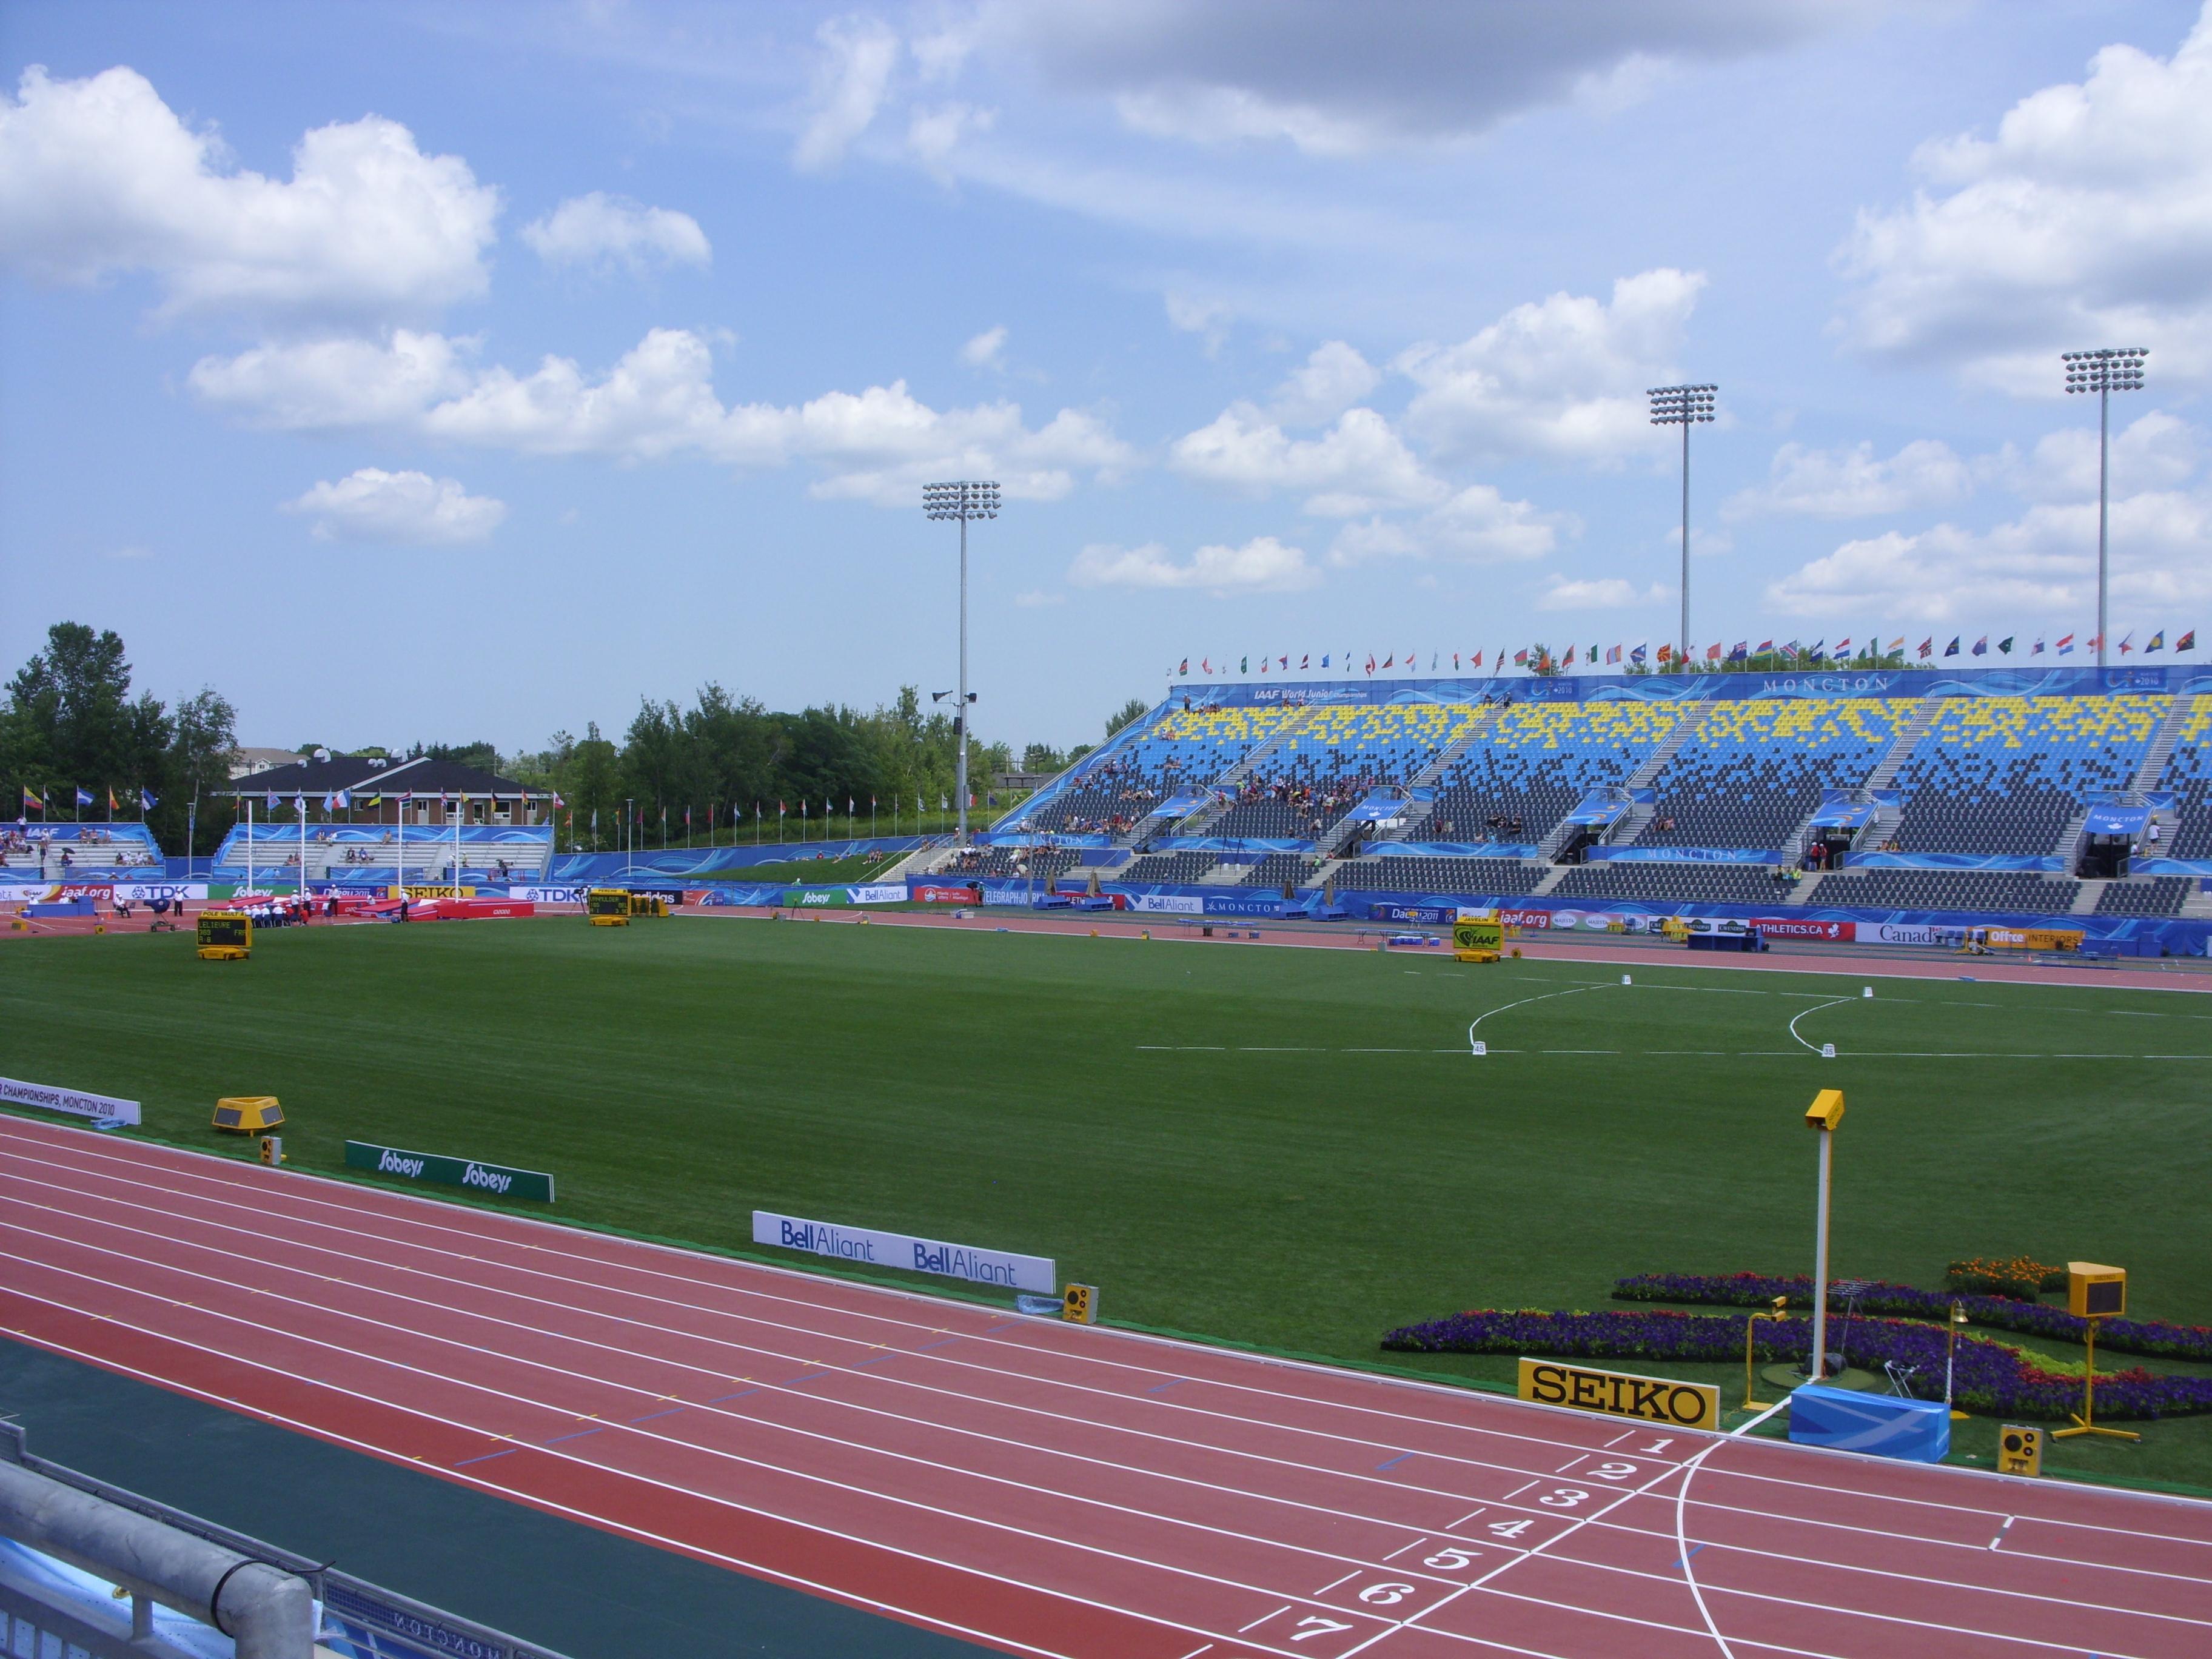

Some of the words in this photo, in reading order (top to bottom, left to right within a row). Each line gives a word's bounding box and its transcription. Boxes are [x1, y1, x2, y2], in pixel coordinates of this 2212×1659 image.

[1763, 678, 1888, 692] MONCTON
[1255, 689, 1280, 699] IAAF
[1282, 689, 1306, 699] World
[1308, 689, 1333, 699] Junior
[27, 828, 60, 837] IAF
[1646, 848, 1737, 860] MONCTON
[61, 886, 111, 900] iaaf.org
[802, 891, 831, 905] Sobeys
[865, 890, 900, 901] BellAliant
[1148, 897, 1195, 911] BellAliant
[1423, 912, 1439, 920] 2011
[1500, 911, 1547, 928] iaaf.org
[1760, 923, 1823, 934] THLETICS.CA
[1473, 935, 1500, 945] IAAF
[1990, 931, 2024, 942] Office
[2028, 934, 2079, 945] INTERIORS
[4, 1085, 61, 1107] CHAMPIONSHIPS,
[62, 1096, 98, 1112] MONCTON
[99, 1102, 115, 1116] 2010
[378, 1149, 424, 1178] Sobeys
[463, 1163, 512, 1193] Sobeys
[781, 1220, 874, 1261] BellAliant
[913, 1242, 1017, 1286] BellAliant
[1532, 1365, 1706, 1425] SEIKO
[1640, 1438, 1674, 1454] 1
[1586, 1462, 1637, 1480] 2
[1539, 1489, 1589, 1507] 3
[1487, 1519, 1535, 1538] 4
[1423, 1547, 1483, 1569] 5
[1358, 1582, 1415, 1604] 6
[1290, 1615, 1353, 1641] 7
